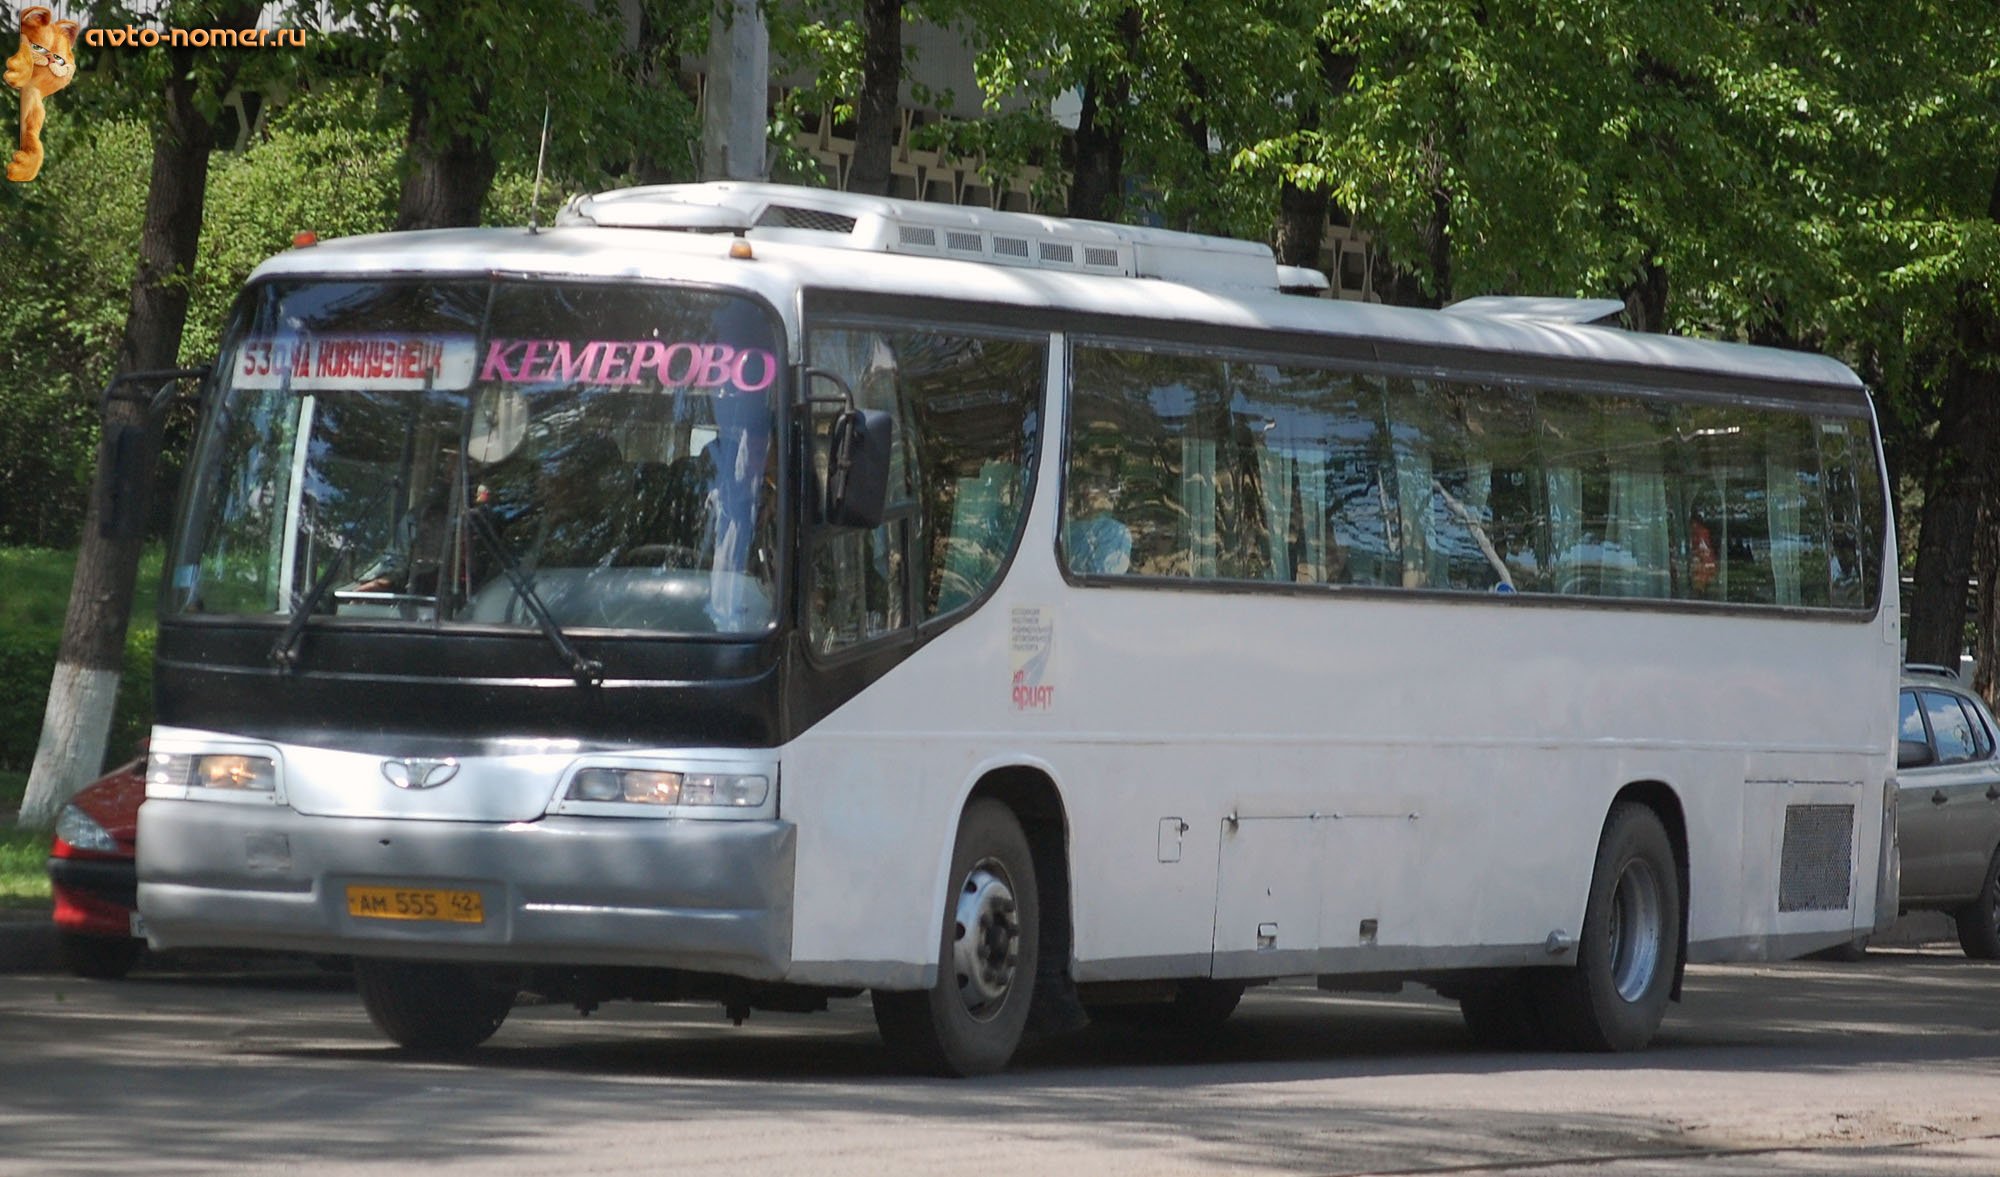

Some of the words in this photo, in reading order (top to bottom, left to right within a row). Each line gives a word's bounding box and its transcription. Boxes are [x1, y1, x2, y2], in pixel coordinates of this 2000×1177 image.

[479, 339, 777, 392] КЕМЕРОВО
[360, 895, 388, 912] АМ
[395, 892, 437, 916] 555
[450, 895, 473, 912] 42
